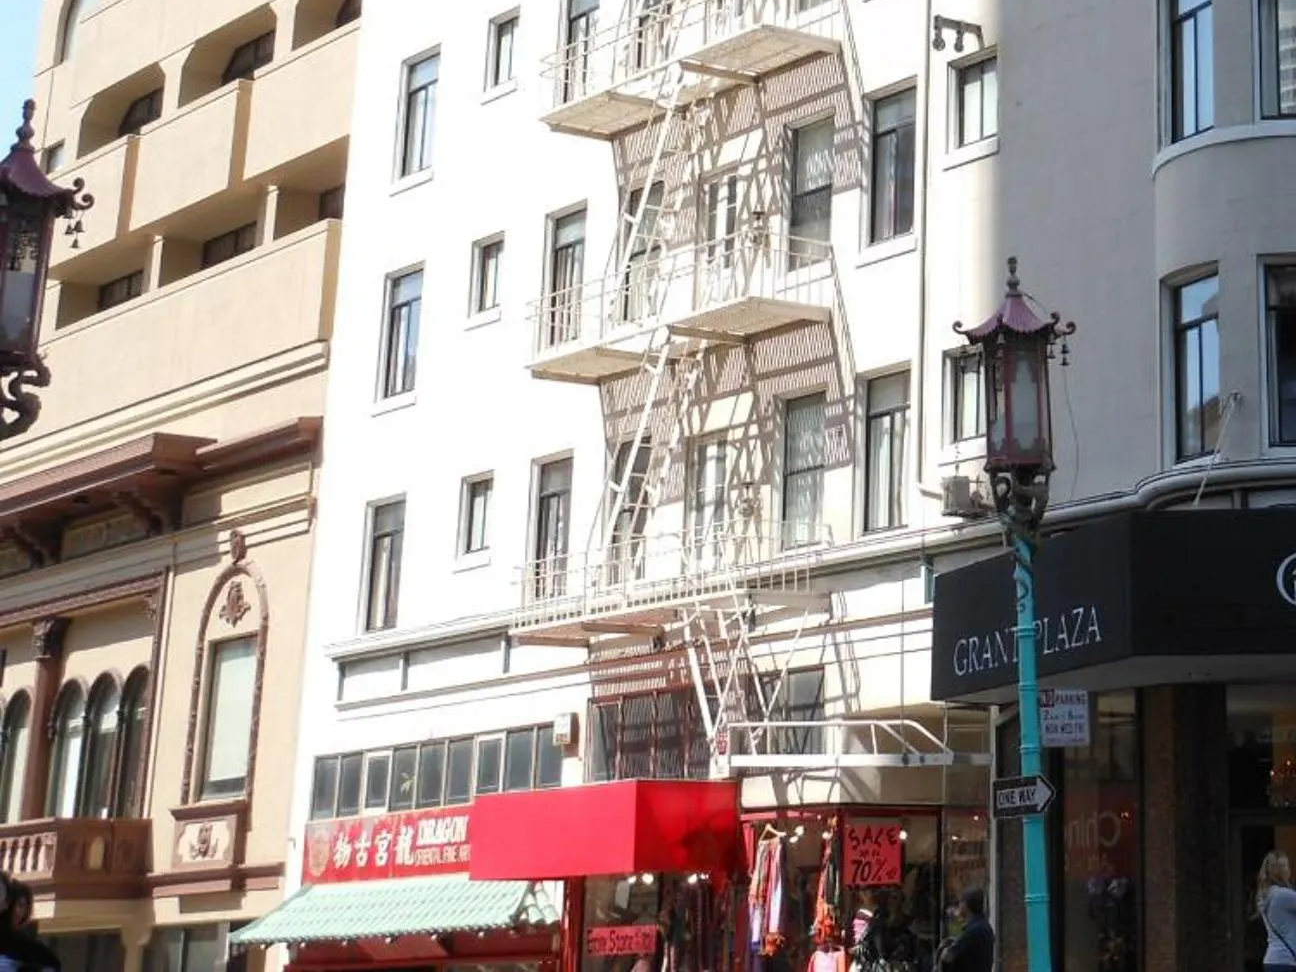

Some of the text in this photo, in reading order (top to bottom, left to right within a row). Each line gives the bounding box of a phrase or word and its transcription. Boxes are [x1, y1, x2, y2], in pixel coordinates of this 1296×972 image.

[953, 625, 1019, 676] GRANT
[1055, 691, 1087, 705] PARKING
[999, 788, 1036, 805] ONE WAY
[416, 815, 470, 847] DRAGON
[847, 827, 898, 849] SALE
[852, 857, 888, 884] 70%
